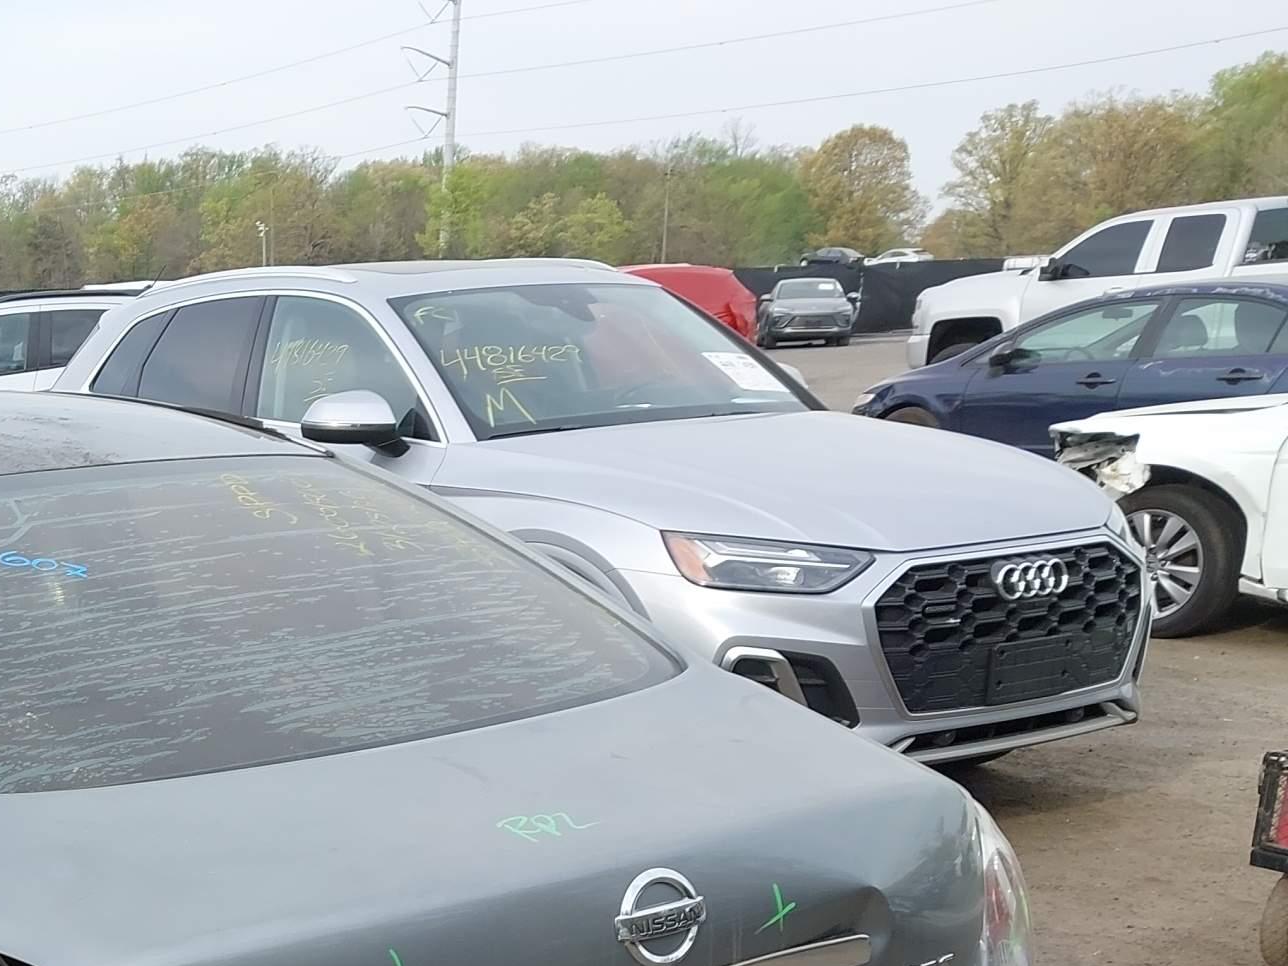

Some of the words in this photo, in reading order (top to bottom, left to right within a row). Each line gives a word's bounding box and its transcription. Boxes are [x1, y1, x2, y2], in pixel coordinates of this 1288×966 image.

[439, 343, 584, 382] 44816429
[485, 387, 538, 429] M
[630, 901, 705, 939] NISSAN
